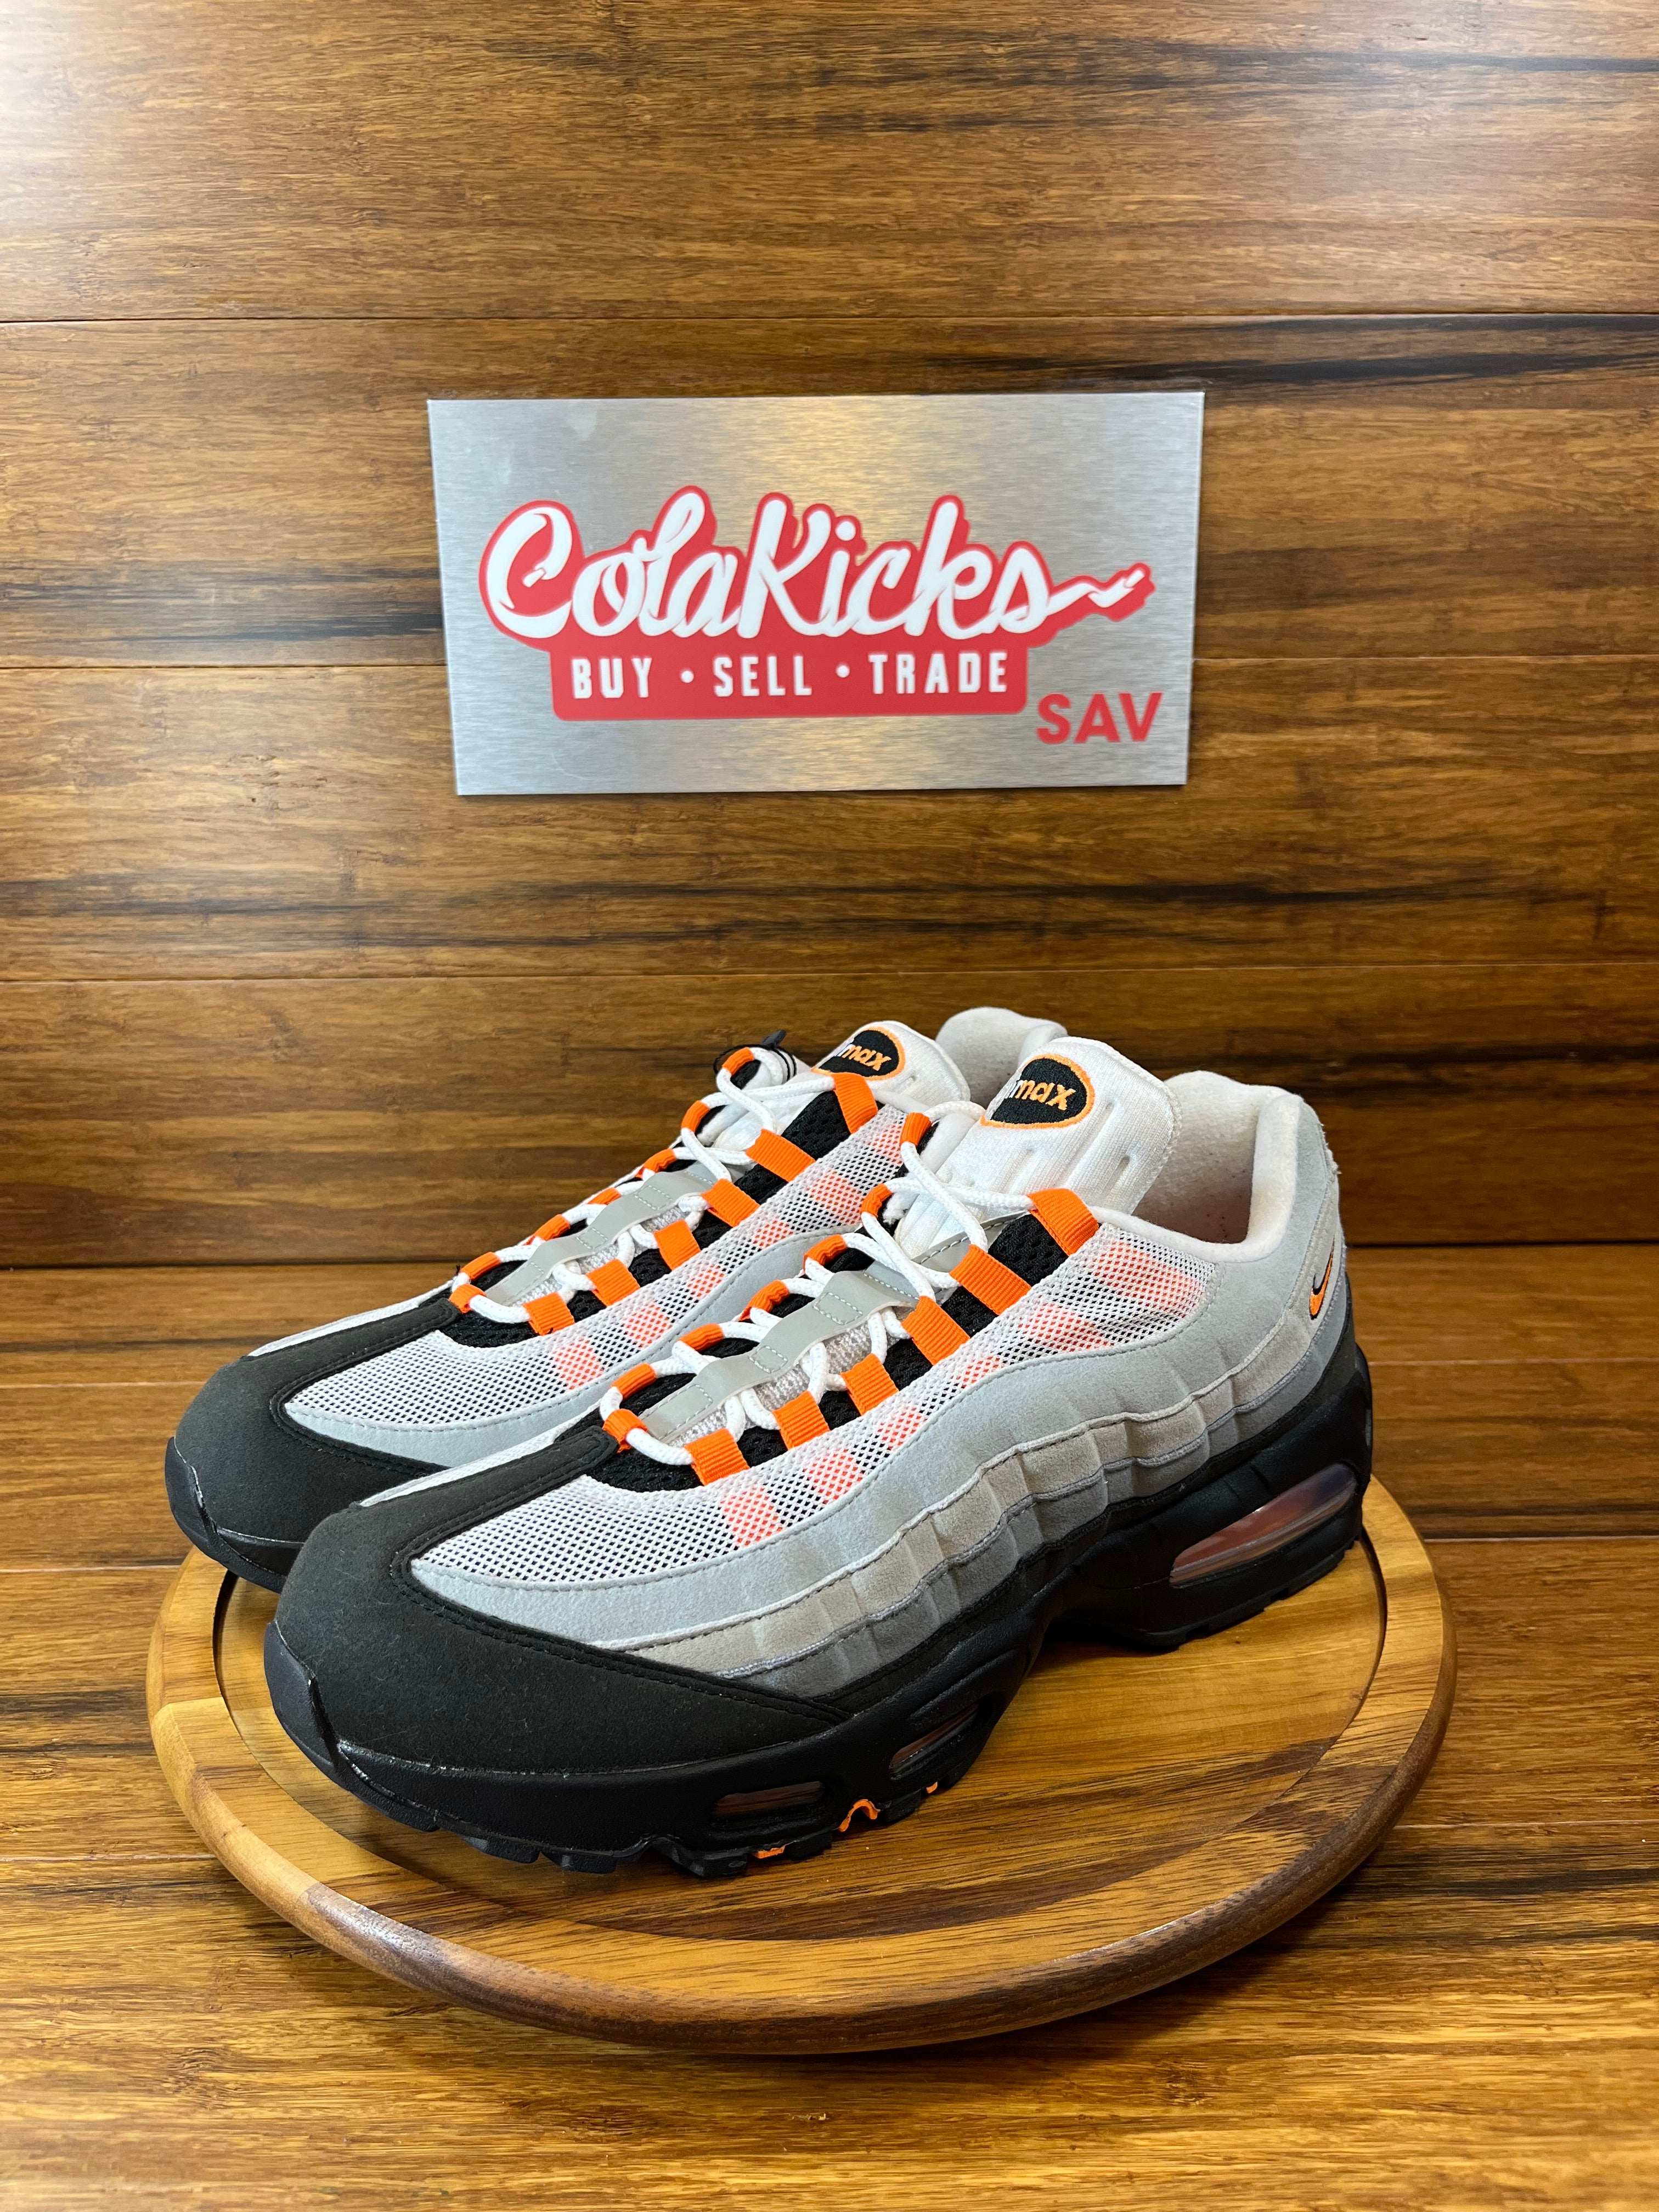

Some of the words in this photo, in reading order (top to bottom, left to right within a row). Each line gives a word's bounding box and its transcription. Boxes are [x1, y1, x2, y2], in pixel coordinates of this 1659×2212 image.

[486, 492, 1146, 640] ColaKicks
[571, 657, 652, 699] BUY
[713, 655, 812, 697] SELL
[868, 652, 1007, 694] TRADE
[1036, 692, 1163, 744] SAV
